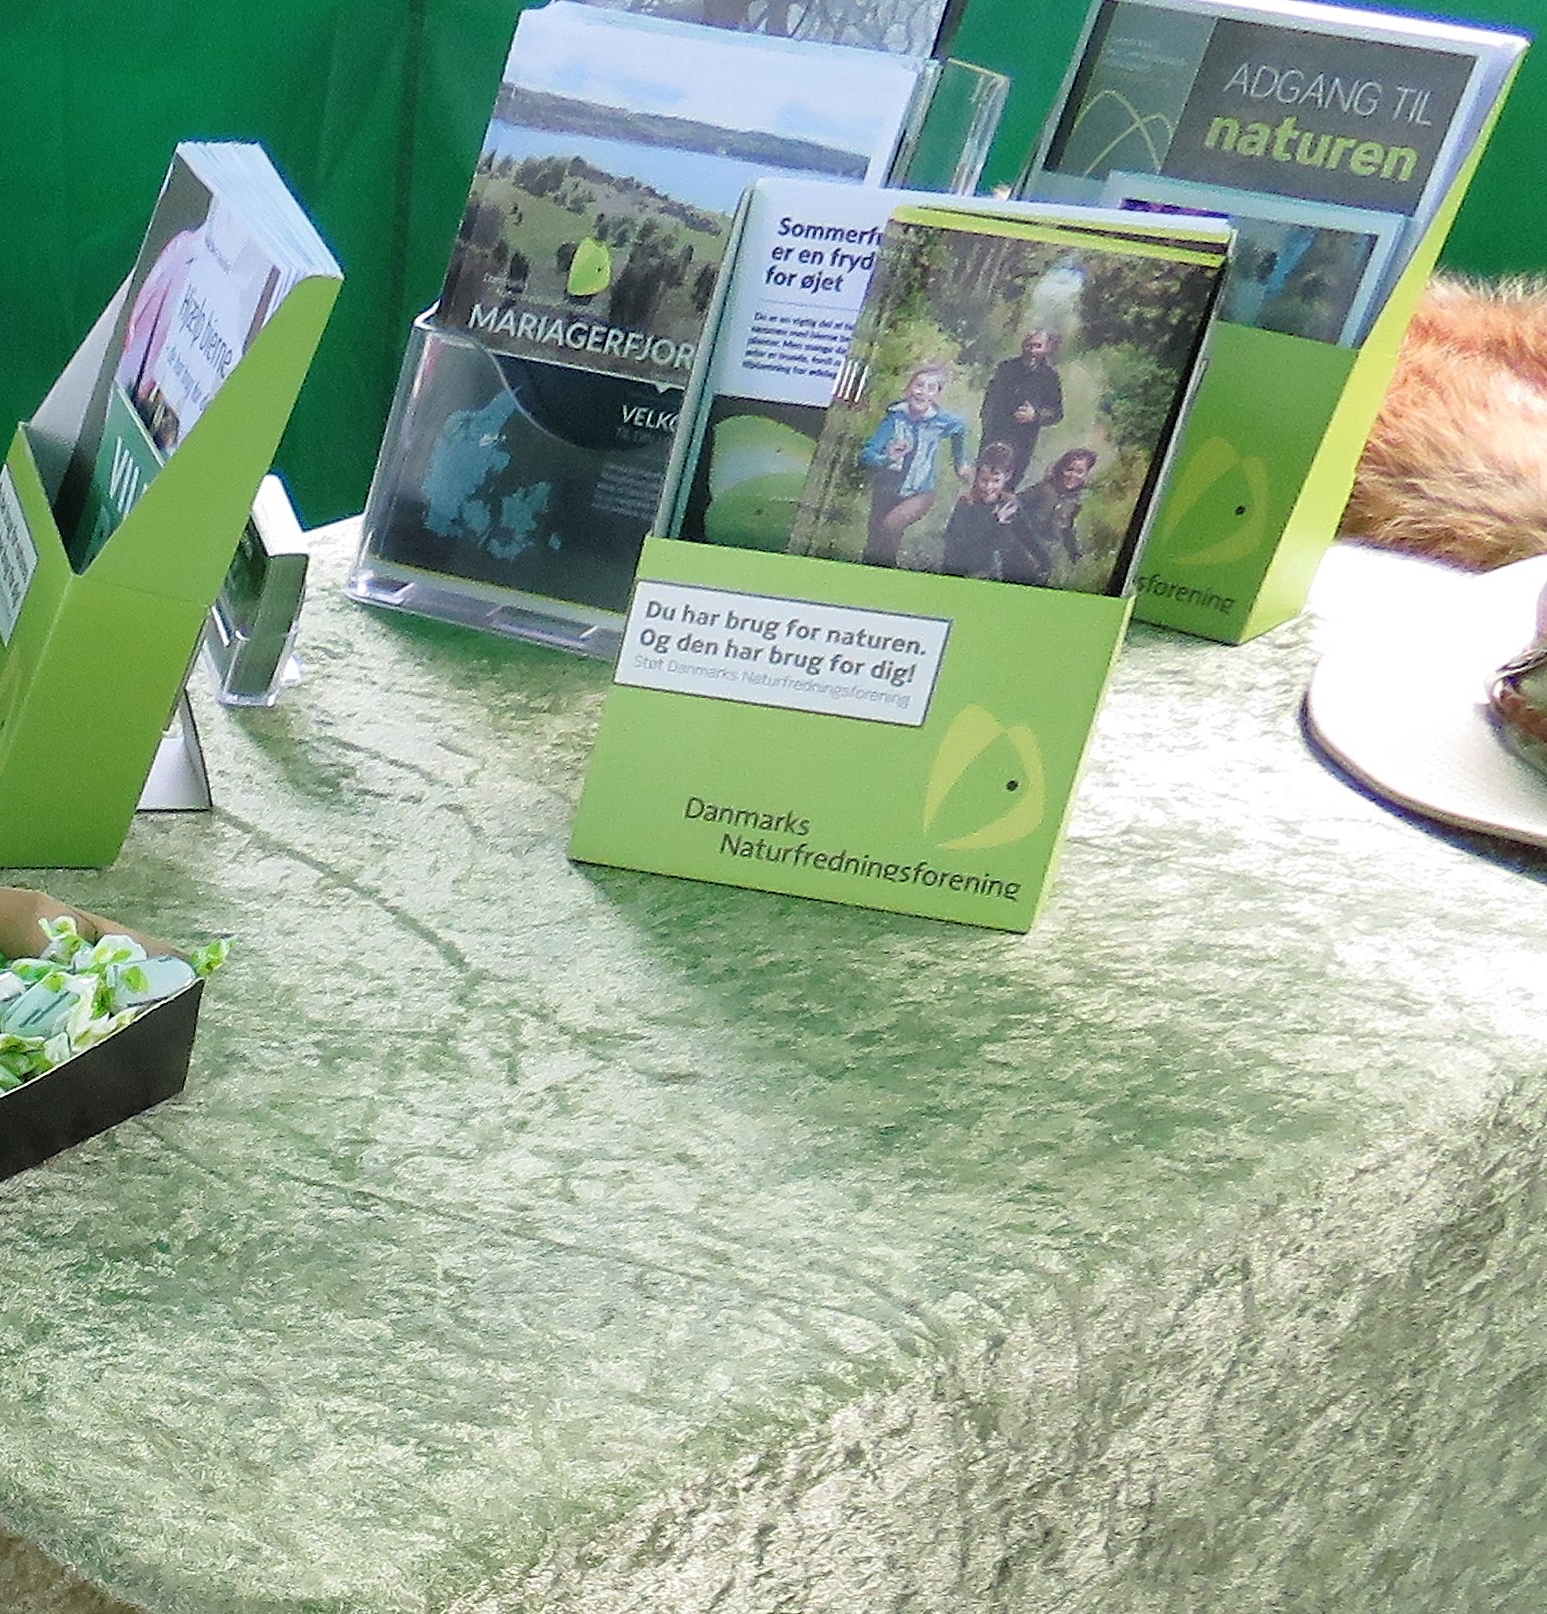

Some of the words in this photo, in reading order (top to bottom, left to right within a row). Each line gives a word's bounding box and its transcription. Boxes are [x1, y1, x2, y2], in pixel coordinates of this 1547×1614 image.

[1222, 62, 1384, 117] ADGANG
[1392, 85, 1434, 128] TIL
[1206, 115, 1420, 183] naturen
[764, 265, 798, 288] for
[800, 271, 845, 295] øjet
[771, 245, 796, 262] er
[798, 249, 824, 266] en
[830, 247, 876, 273] fryd
[467, 302, 697, 371] MARIAGERFJOR
[640, 628, 670, 654] Og
[675, 631, 719, 657] den
[725, 639, 763, 663] har
[768, 648, 825, 677] brug
[829, 653, 867, 677] for
[870, 660, 917, 687] dig!
[645, 600, 676, 621] Du
[680, 603, 720, 628] har
[725, 609, 778, 641] brug
[785, 618, 823, 642] for
[826, 626, 927, 657] naturen.
[633, 654, 665, 670] Støt
[667, 658, 738, 683] Danmarks
[741, 669, 912, 709] Naturfredningsforening
[682, 796, 811, 837] Danmarks
[718, 832, 1022, 902] Naturfredningsforening
